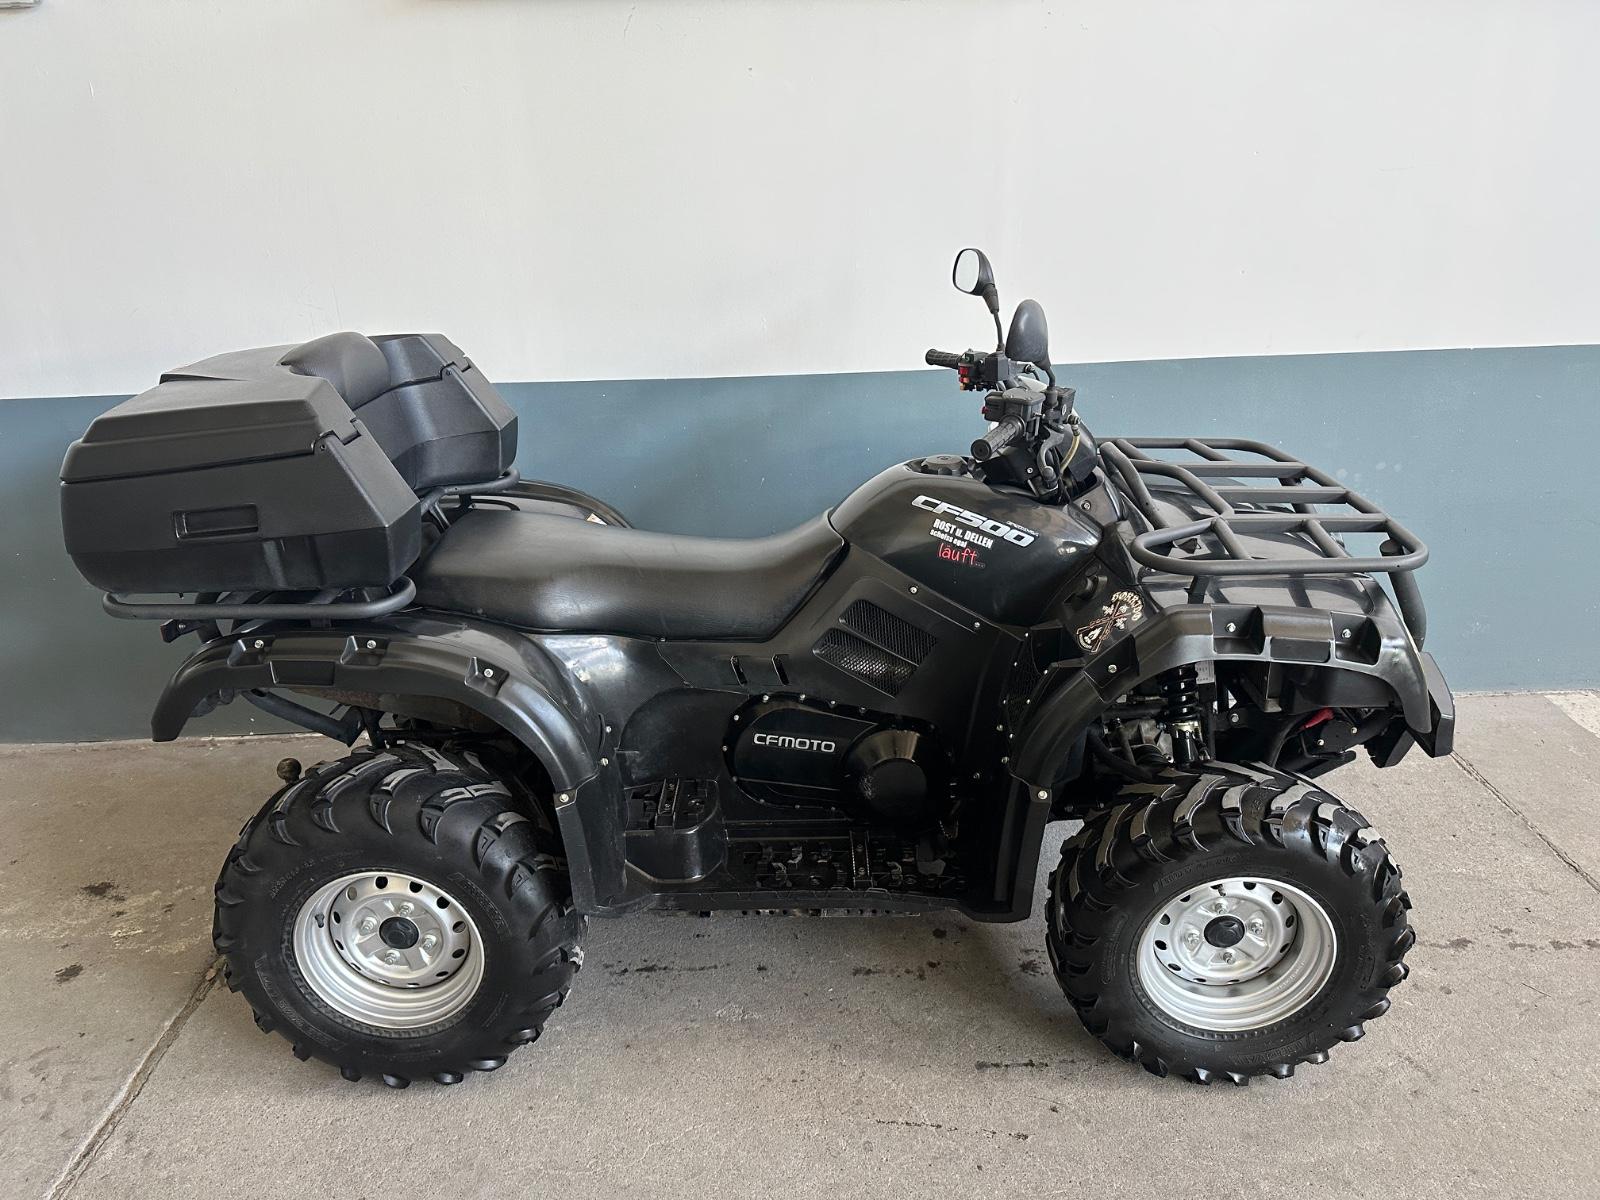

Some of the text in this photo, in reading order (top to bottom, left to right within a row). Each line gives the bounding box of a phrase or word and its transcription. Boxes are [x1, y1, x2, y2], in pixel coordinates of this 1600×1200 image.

[911, 494, 1035, 547] CF500
[933, 518, 957, 536] ROST
[964, 531, 994, 549] DELLEN
[753, 733, 836, 753] CFMOTO
